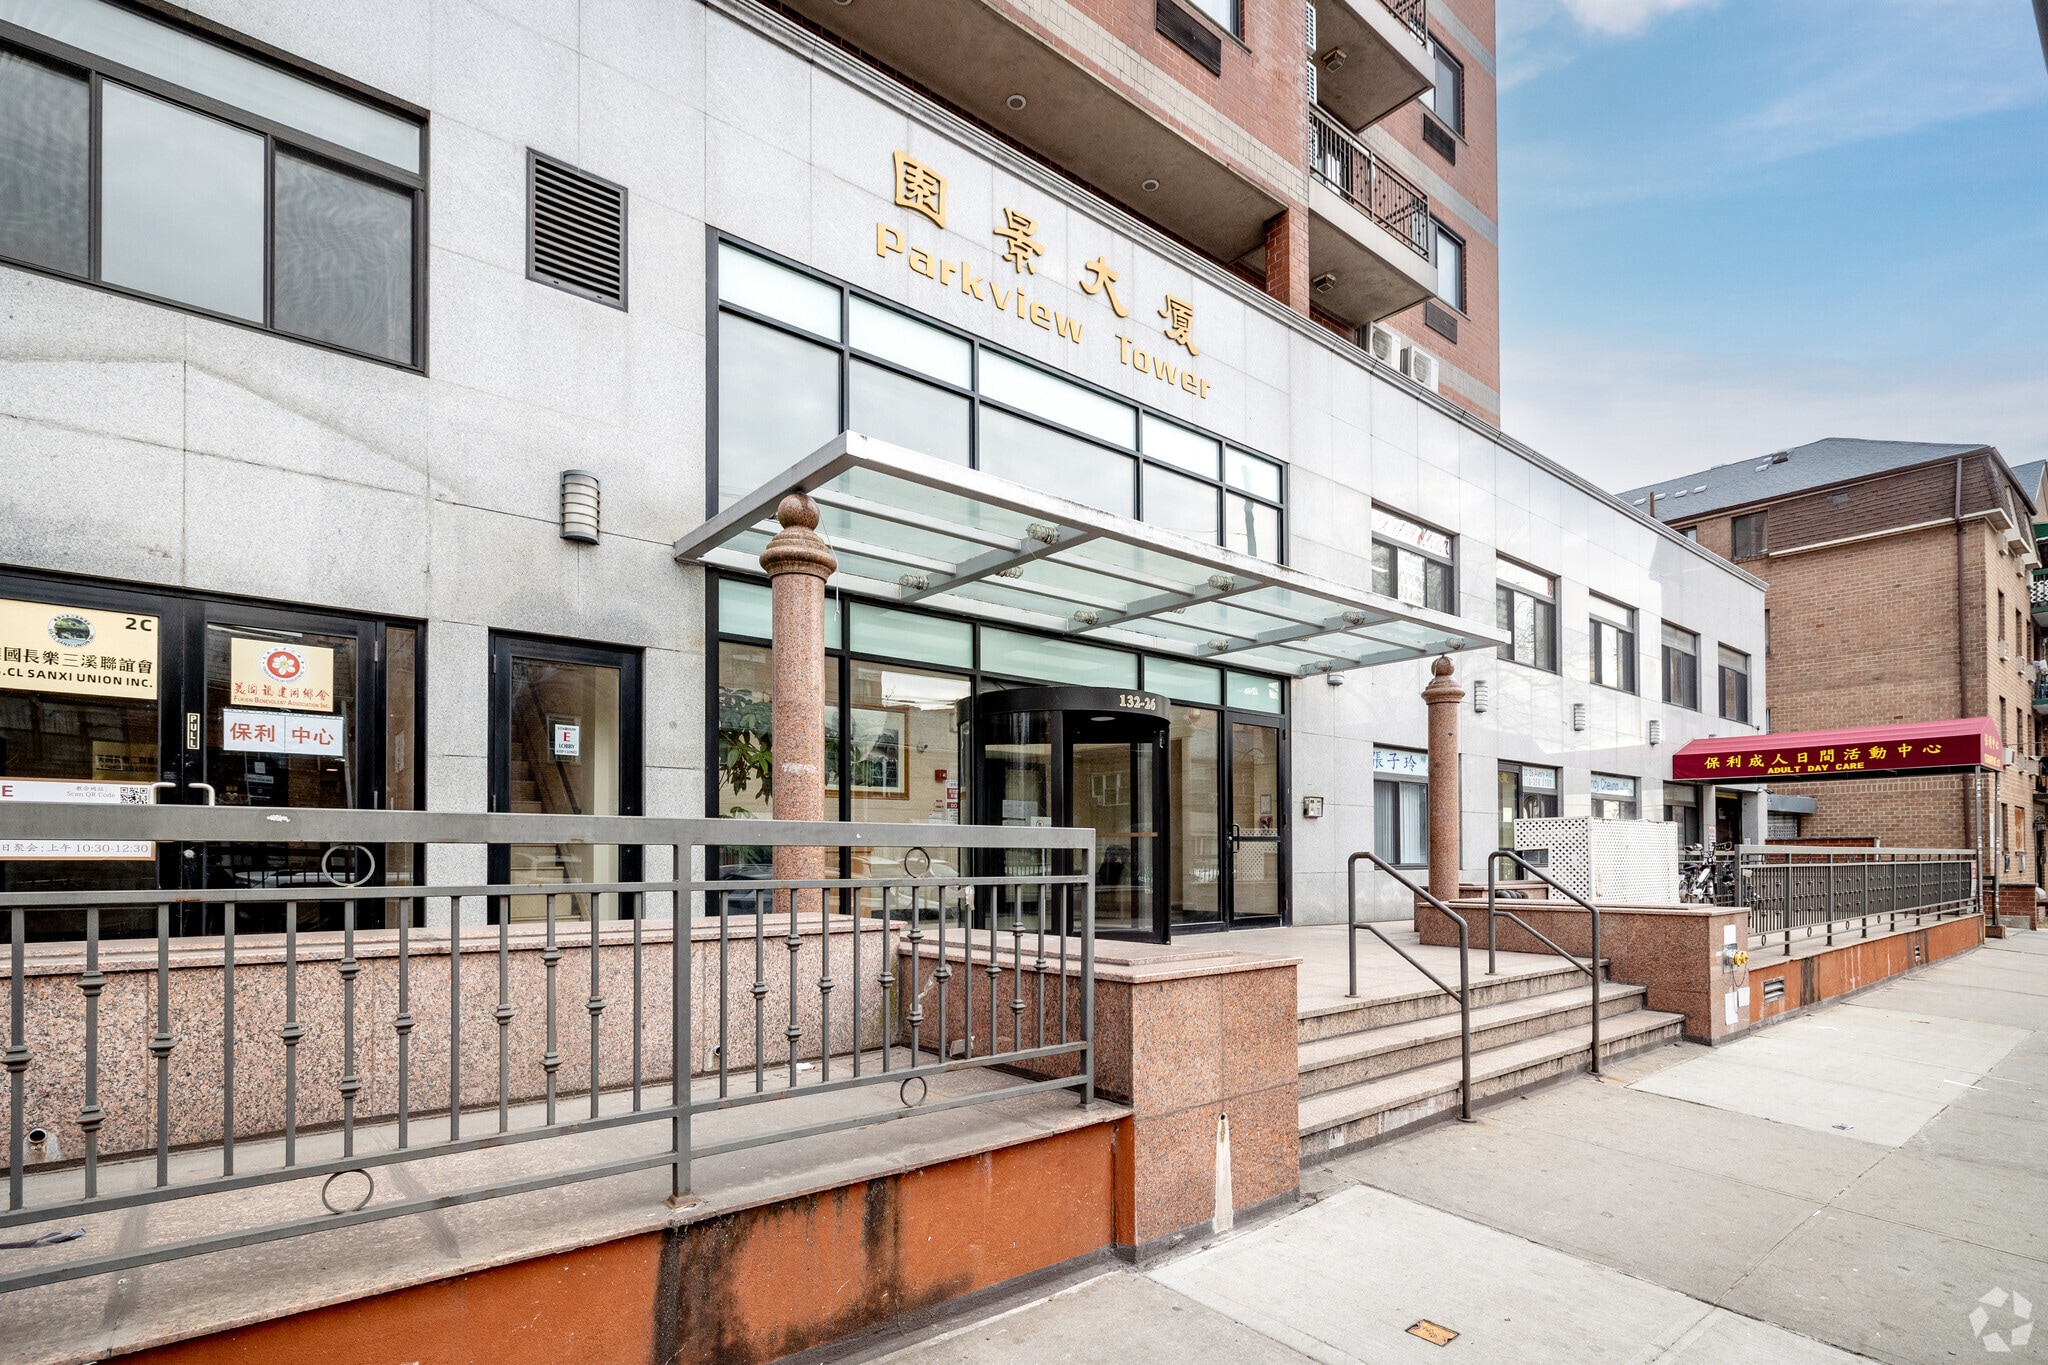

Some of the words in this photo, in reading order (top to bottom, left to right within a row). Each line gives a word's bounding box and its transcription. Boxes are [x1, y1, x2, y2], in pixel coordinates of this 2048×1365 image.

[876, 222, 1085, 344] Parkview
[1115, 332, 1212, 399] Tower
[125, 617, 152, 632] 2C
[0, 646, 153, 675] 國長樂三溪聯誼會
[27, 669, 73, 682] SANXI
[76, 673, 122, 686] UNION
[126, 677, 153, 688] INC.
[1119, 694, 1156, 711] 132-26
[190, 714, 198, 749] PULL
[229, 722, 276, 743] 保利
[291, 726, 335, 746] 中心
[563, 732, 571, 742] E
[1767, 766, 1801, 775] ADULT
[1807, 764, 1829, 773] DAY
[1835, 761, 1865, 771] CARE
[86, 791, 97, 799] QR
[76, 844, 149, 853] 10:30-12:30
